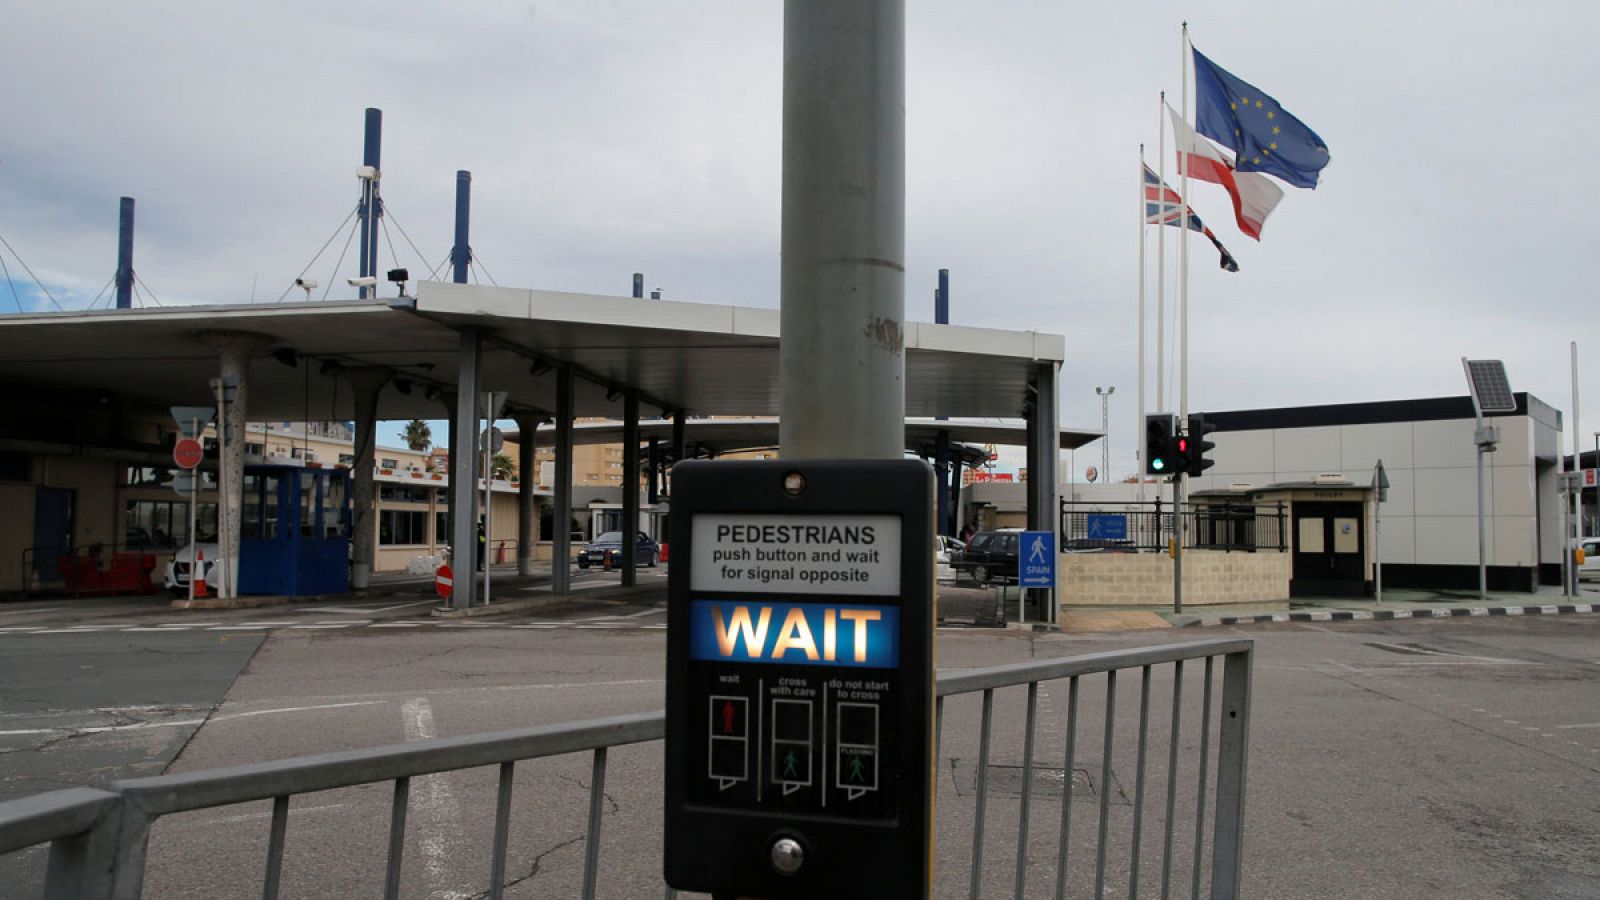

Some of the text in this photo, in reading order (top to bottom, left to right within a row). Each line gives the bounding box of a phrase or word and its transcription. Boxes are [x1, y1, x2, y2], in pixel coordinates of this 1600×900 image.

[716, 524, 876, 545] PEDESTRIANS
[713, 548, 880, 563] push button and wait
[721, 565, 869, 584] for signal opposite
[1026, 566, 1050, 574] SPAIN
[711, 605, 882, 663] WAIT
[719, 674, 740, 684] wait
[778, 677, 807, 686] cross
[829, 679, 889, 691] do not start
[769, 686, 817, 697] with care
[837, 689, 881, 700] to cross
